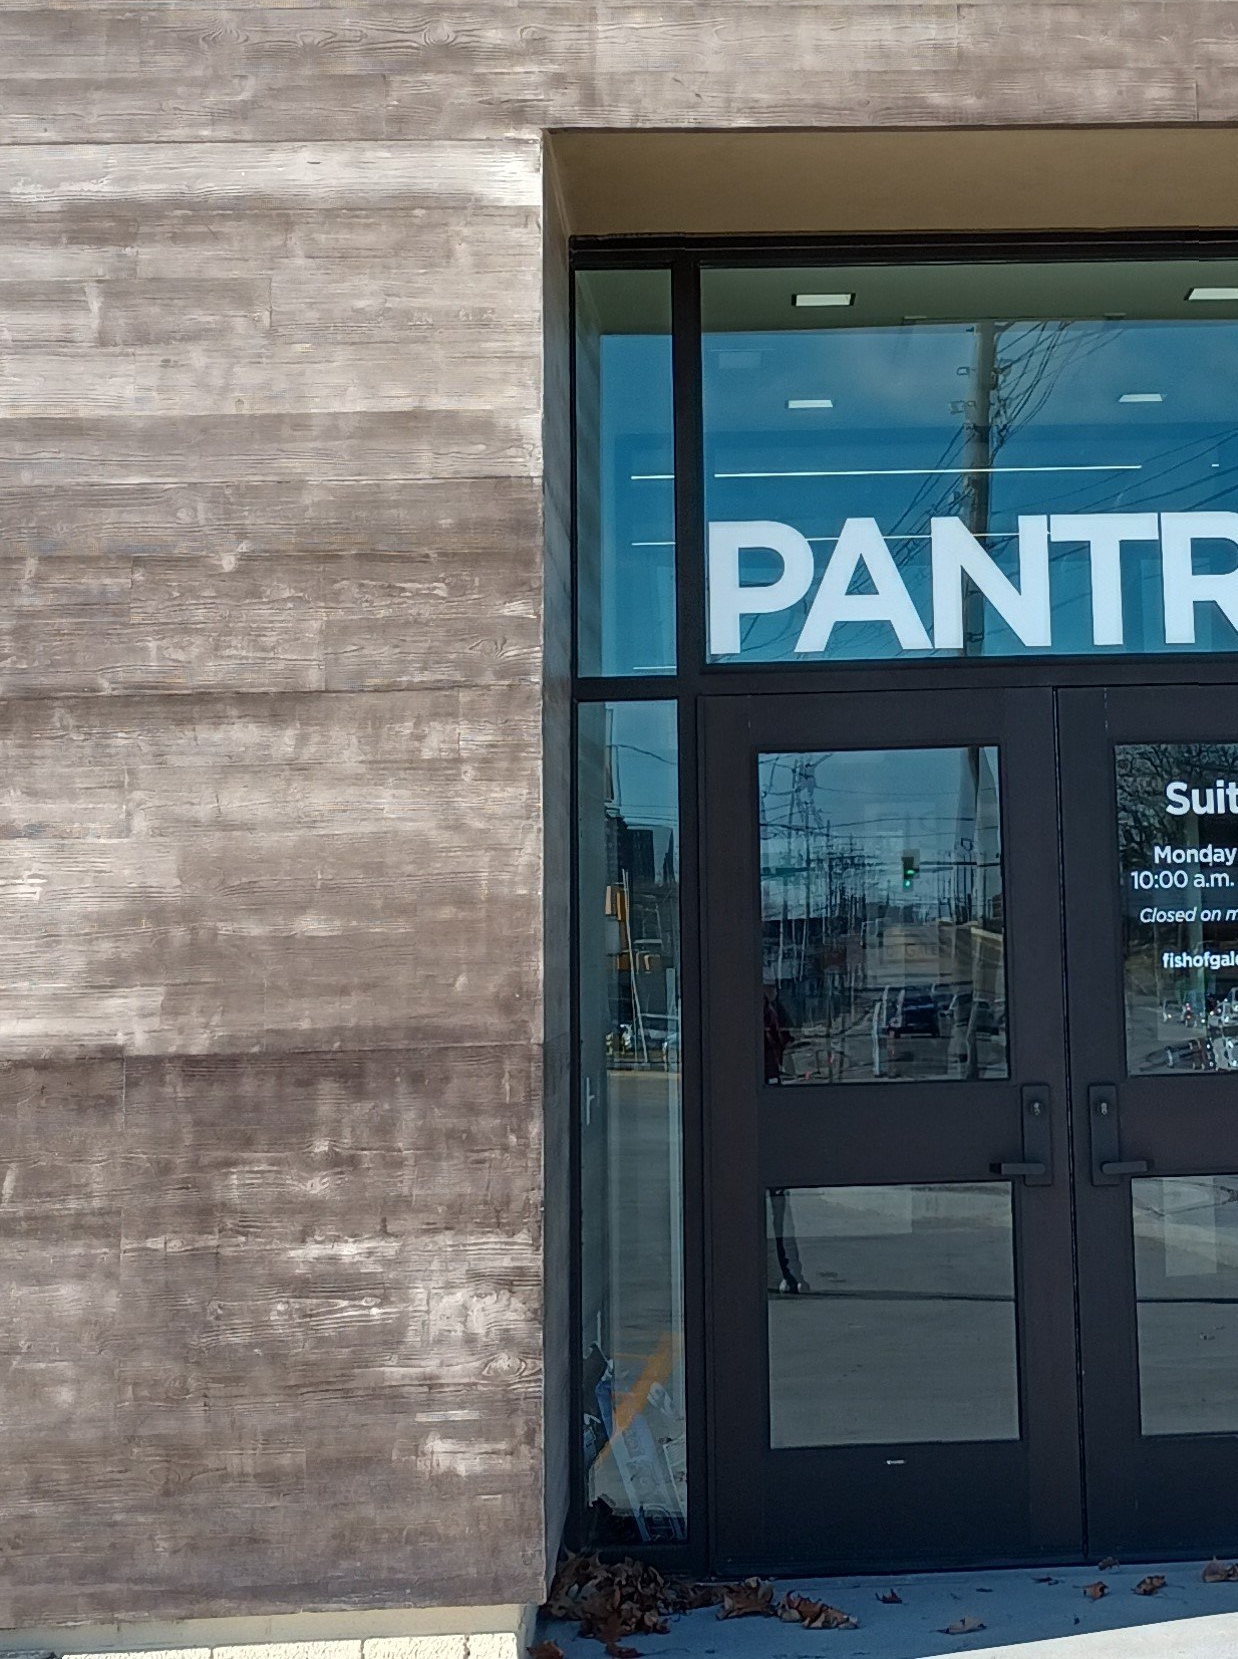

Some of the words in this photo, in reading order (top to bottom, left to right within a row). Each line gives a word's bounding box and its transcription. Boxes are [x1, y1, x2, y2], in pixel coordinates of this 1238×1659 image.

[1153, 844, 1238, 866] Monday
[1130, 870, 1189, 890] 10:00
[1193, 873, 1235, 888] a.m.
[1139, 907, 1198, 923] Closed
[1200, 909, 1222, 921] on
